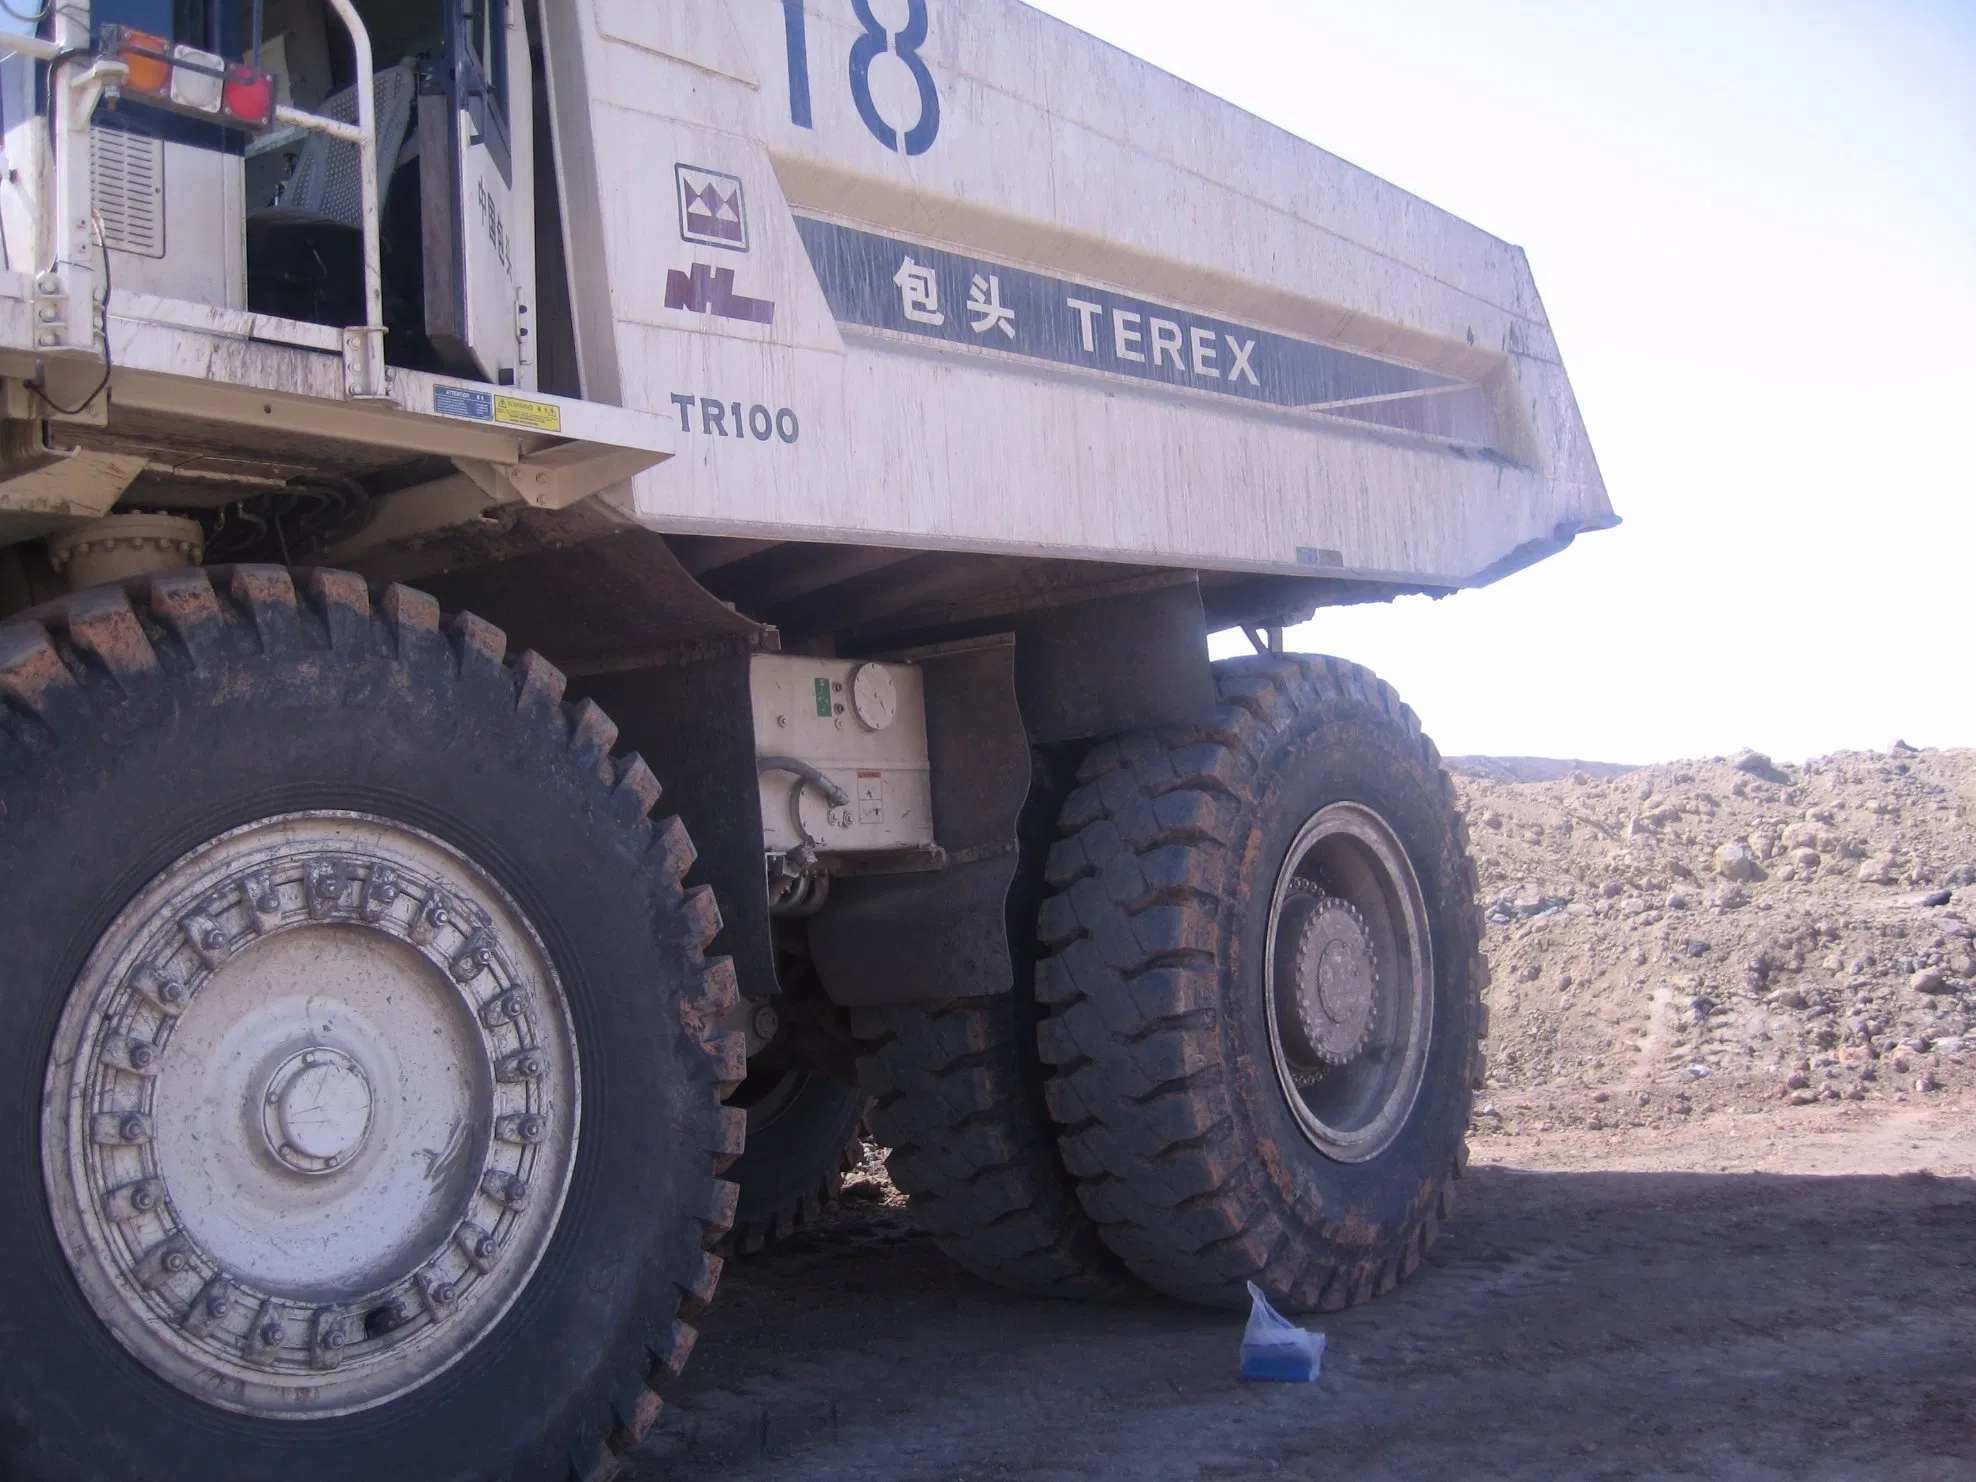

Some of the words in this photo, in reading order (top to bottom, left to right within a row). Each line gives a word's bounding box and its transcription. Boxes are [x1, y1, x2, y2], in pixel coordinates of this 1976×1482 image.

[663, 262, 776, 325] NHL
[893, 255, 1016, 340] 包头
[1066, 297, 1261, 387] TEREX
[670, 392, 800, 444] TR100
